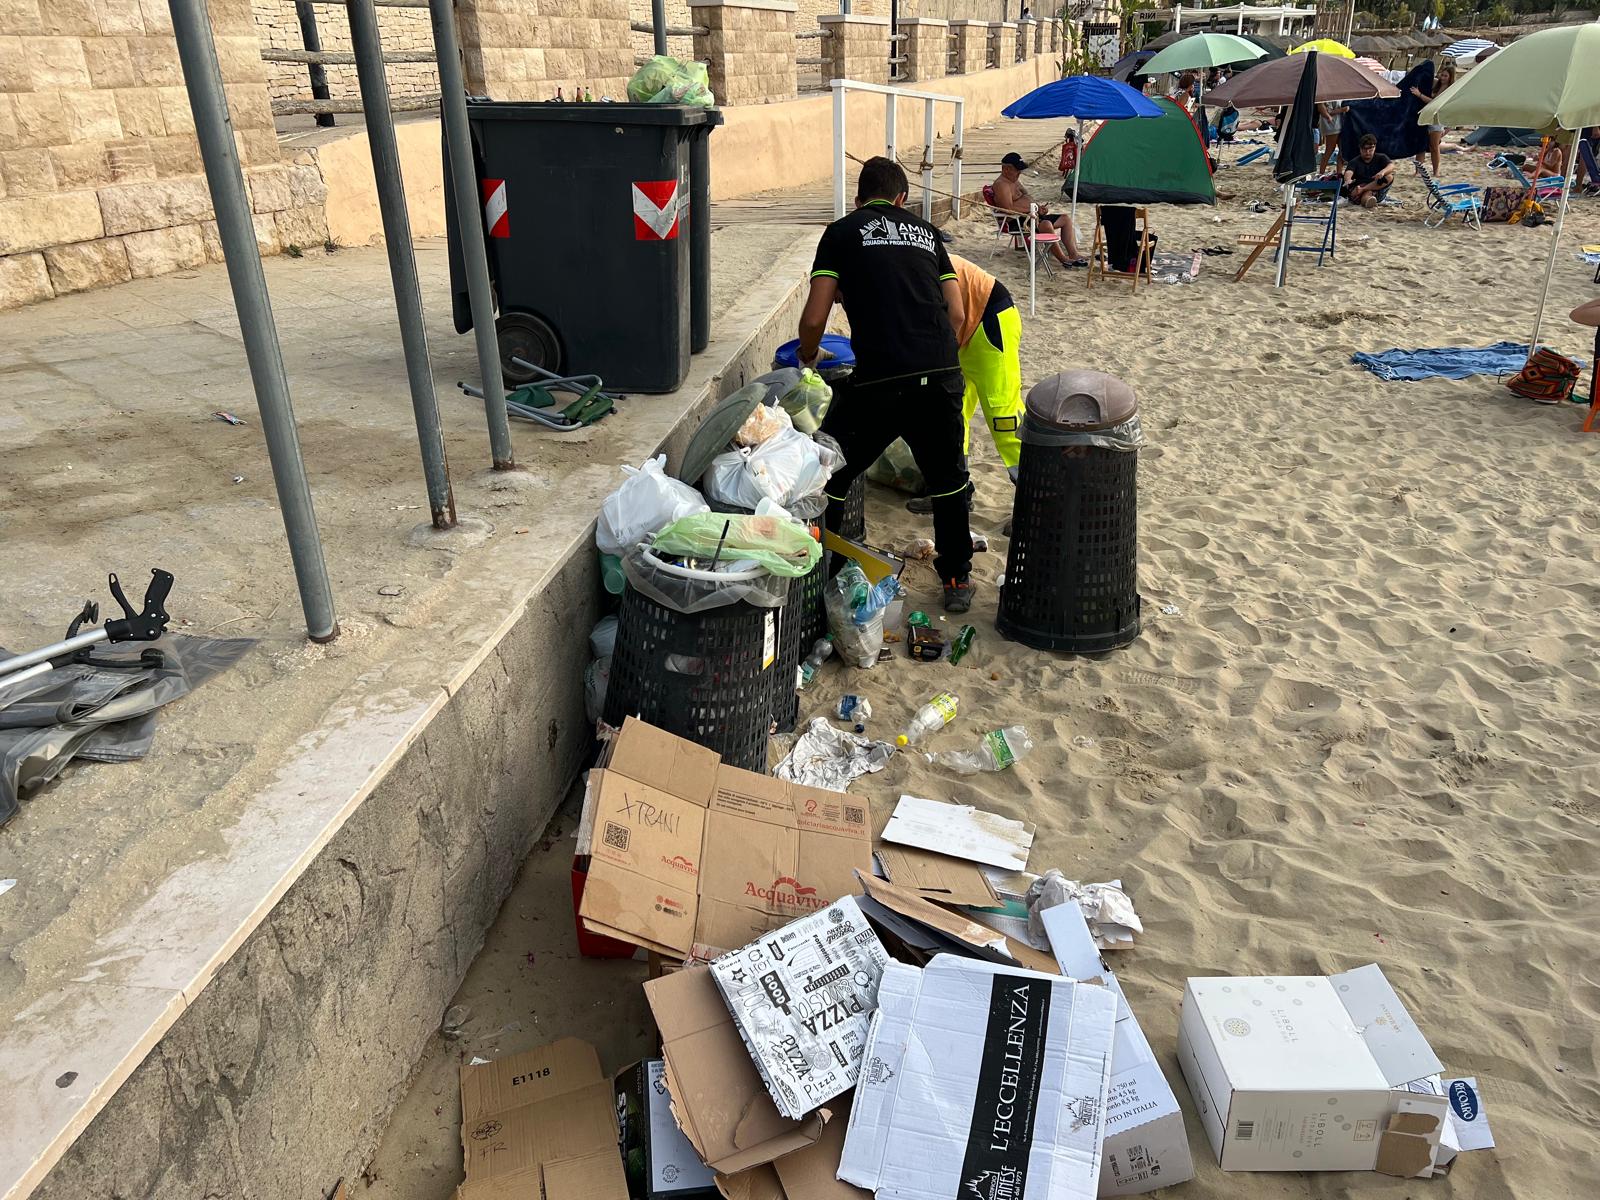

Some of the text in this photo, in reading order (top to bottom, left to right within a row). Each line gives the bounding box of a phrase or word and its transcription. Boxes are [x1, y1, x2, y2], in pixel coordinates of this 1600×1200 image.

[899, 222, 934, 238] AMIU
[900, 232, 935, 250] TRANI
[661, 855, 698, 875] Acquaviva
[744, 881, 830, 909] Acquaviva
[813, 934, 832, 964] Fornarina
[764, 974, 787, 1005] GOOD
[801, 994, 863, 1037] PIZZA
[780, 1034, 812, 1080] PIZZA
[831, 1042, 846, 1065] Delivery
[990, 984, 1030, 1152] L'ECCELLENZA
[512, 1067, 551, 1086] E1118
[1124, 1110, 1134, 1119] IN
[1133, 1101, 1158, 1115] ITALIA
[1453, 1082, 1474, 1120] RECOARO
[1313, 1112, 1328, 1148] LIBOLL
